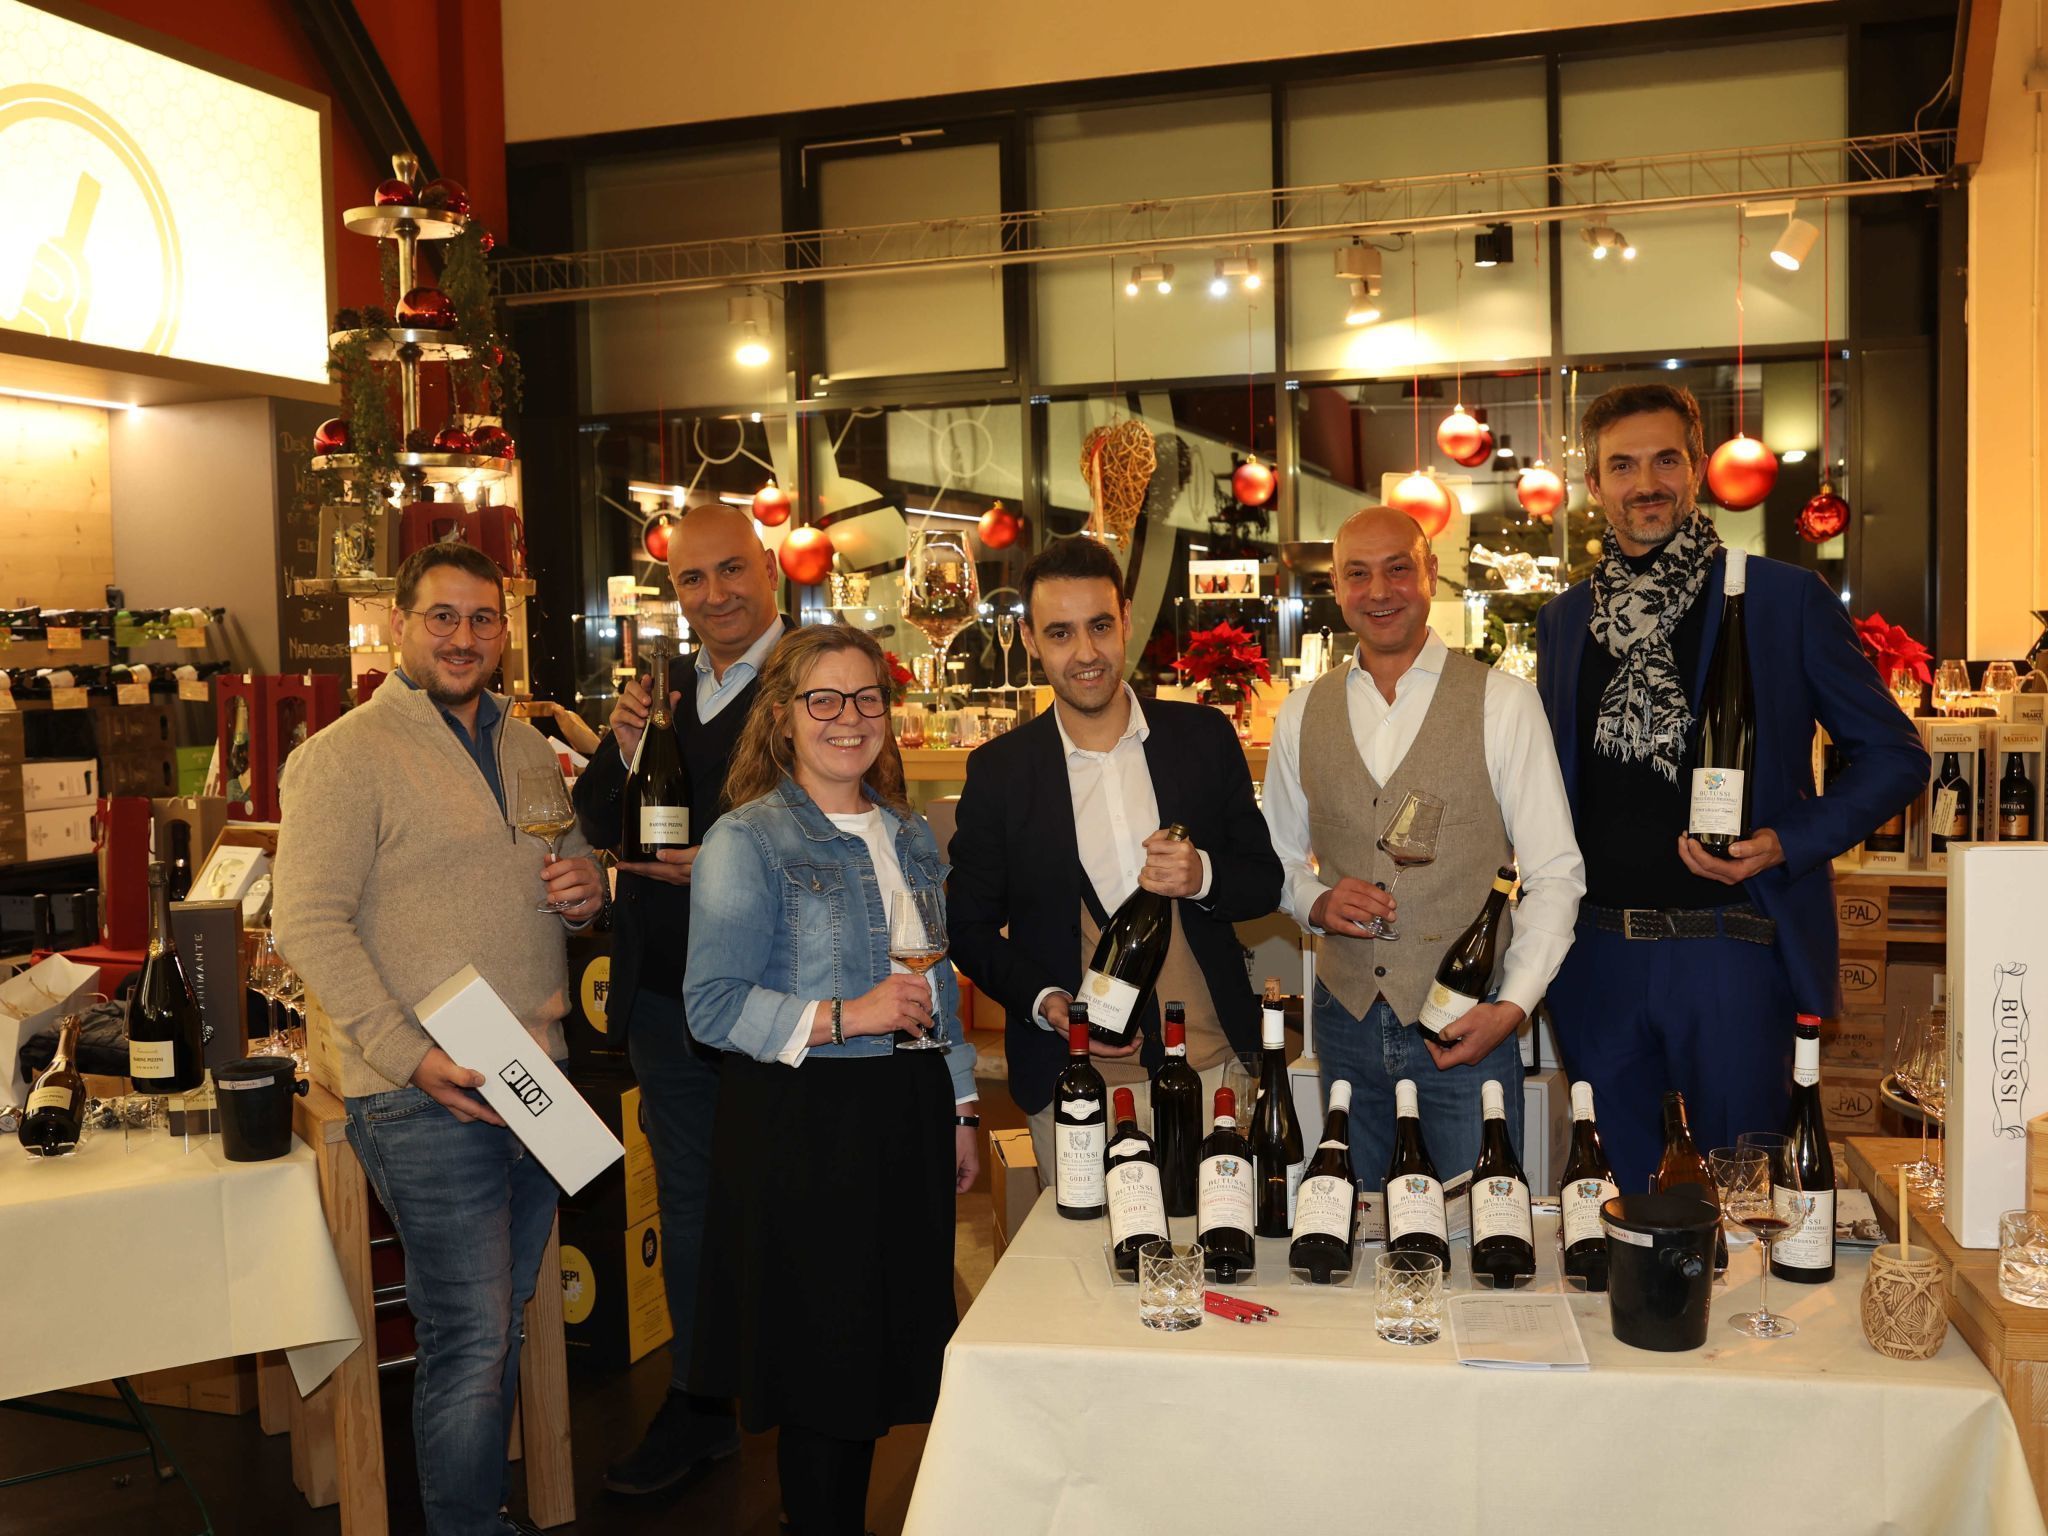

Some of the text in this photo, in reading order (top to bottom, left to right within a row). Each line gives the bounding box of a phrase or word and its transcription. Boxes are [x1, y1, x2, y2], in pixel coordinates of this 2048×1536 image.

[1936, 735, 1972, 743] MARTHA'S
[2003, 735, 2039, 743] MARTHA'S
[1840, 905, 1873, 920] EPAL
[2001, 999, 2019, 1103] BUTUSSI
[1063, 1151, 1098, 1159] BUTUSSI
[1208, 1178, 1248, 1188] BUTUSSI
[1115, 1183, 1154, 1196] BUTUSSI
[1400, 1194, 1437, 1203] BUTUSSI
[1483, 1197, 1520, 1205] BUTUSSI
